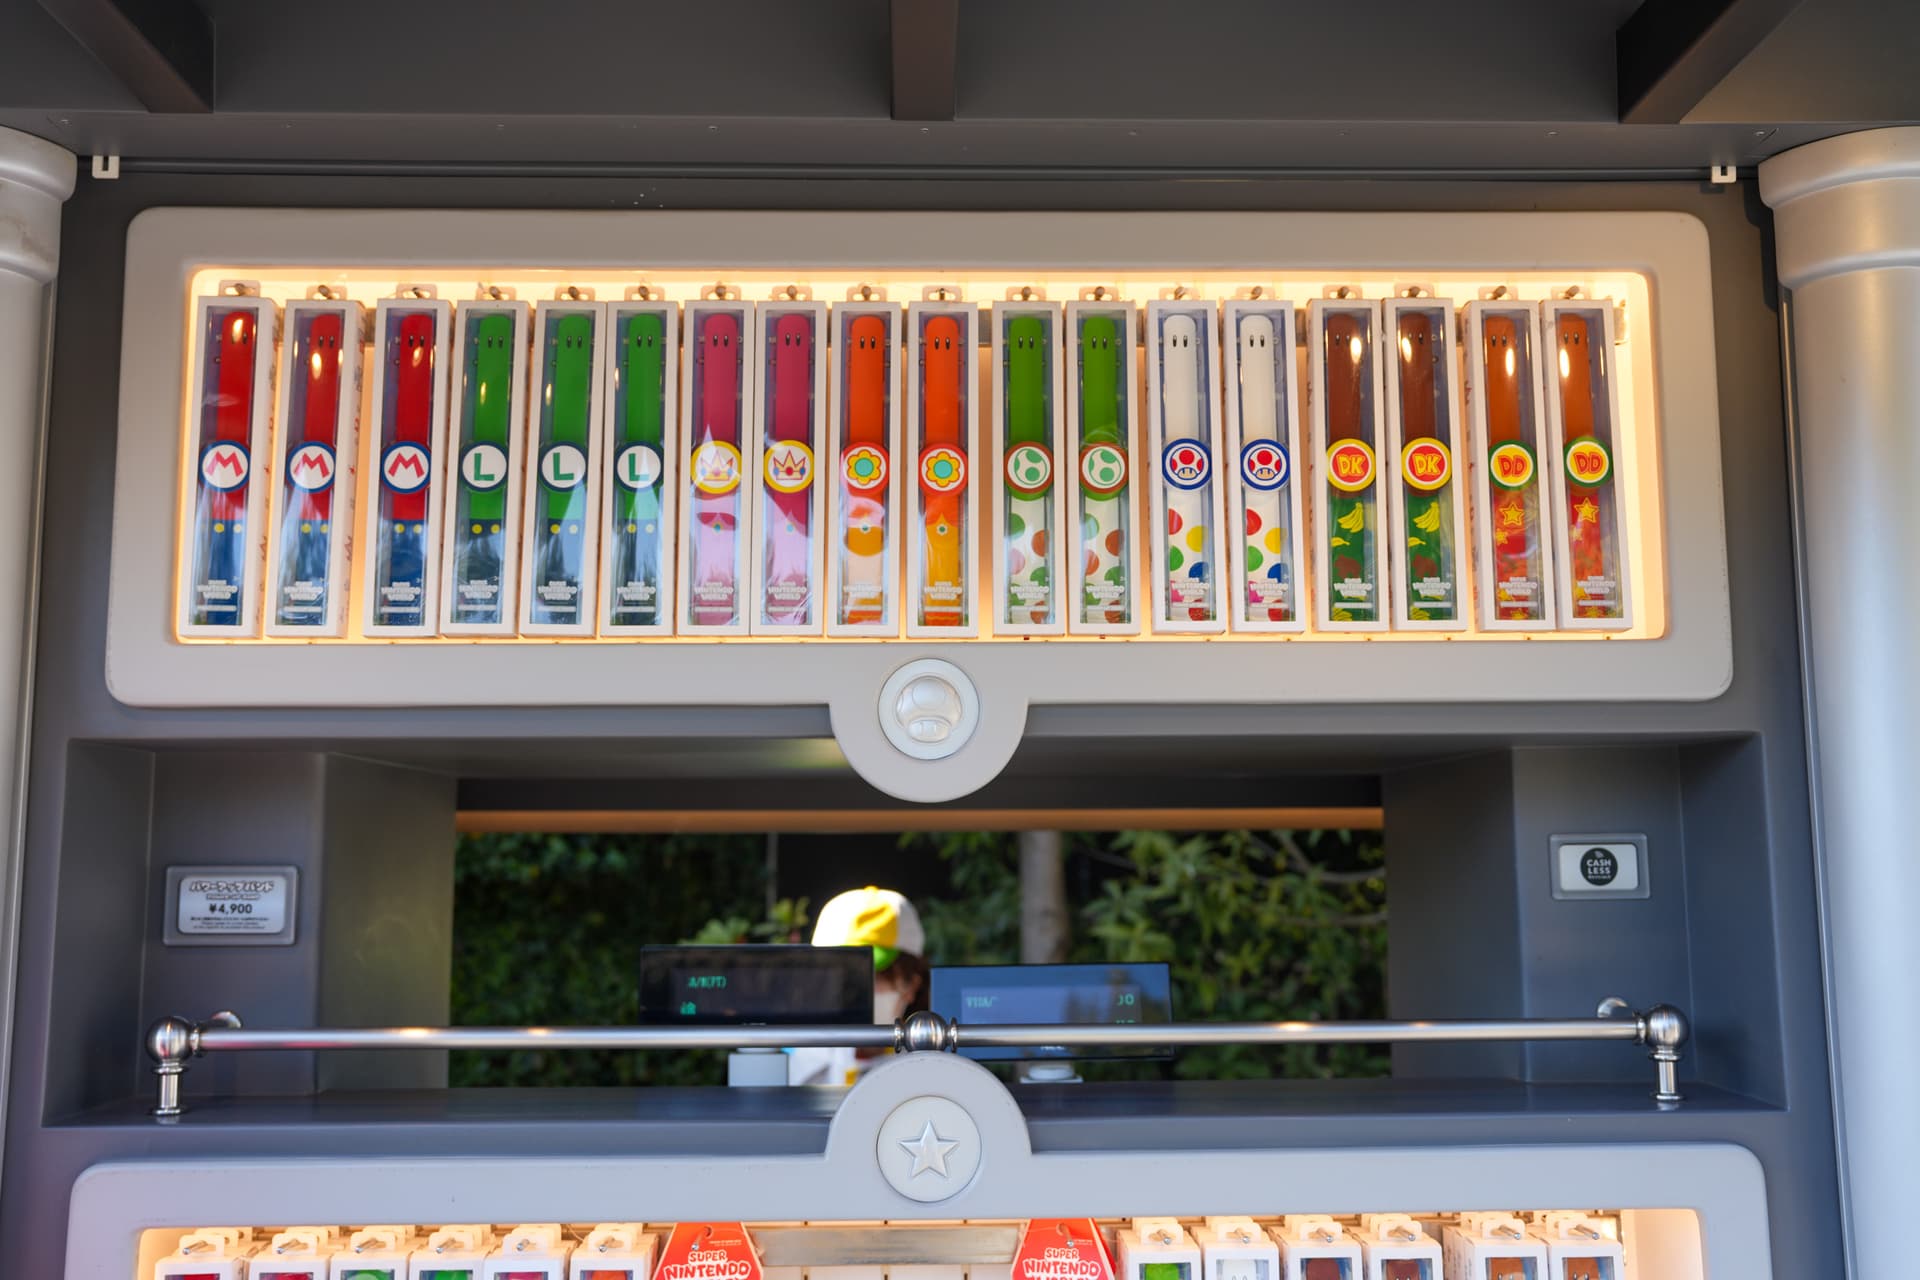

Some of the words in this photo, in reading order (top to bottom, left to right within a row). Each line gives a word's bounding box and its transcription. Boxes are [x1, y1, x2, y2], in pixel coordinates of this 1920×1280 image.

[205, 450, 244, 477] M
[293, 452, 330, 478] M
[388, 453, 425, 478] M
[474, 452, 495, 481] L
[552, 452, 575, 481] L
[628, 453, 650, 481] L
[1336, 453, 1366, 476] DK
[1413, 452, 1442, 475] DK
[1497, 455, 1525, 478] DD
[1574, 452, 1602, 475] DD
[1586, 859, 1612, 867] CASH
[1588, 867, 1611, 875] LESS
[209, 903, 253, 915] ¥4,900
[688, 1249, 728, 1263] SUPER
[1045, 1247, 1080, 1261] SUPER
[663, 1261, 752, 1279] NINTENDO
[1022, 1258, 1102, 1278] NINTENDO
